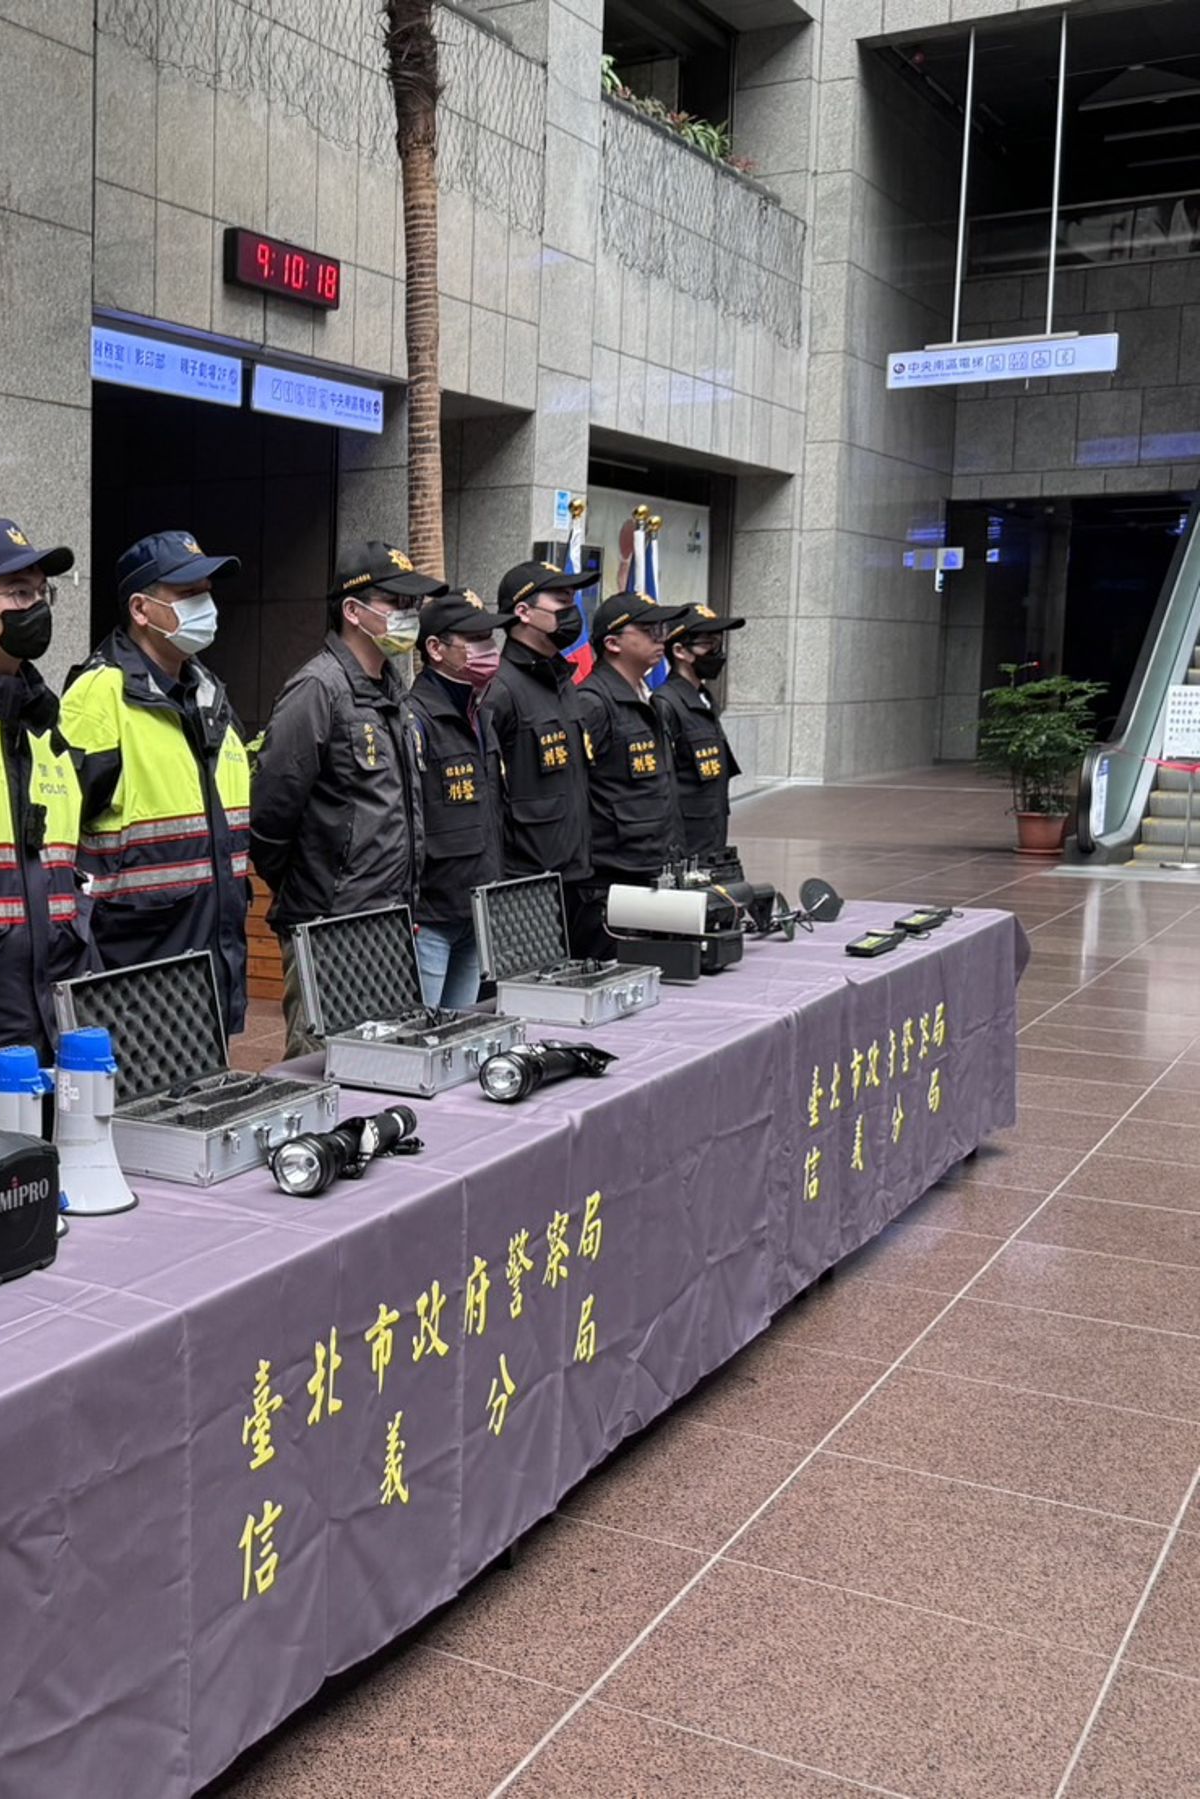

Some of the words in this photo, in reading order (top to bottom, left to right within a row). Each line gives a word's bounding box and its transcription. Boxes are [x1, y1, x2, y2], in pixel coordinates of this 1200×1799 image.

[257, 243, 337, 299] 9:10:18
[239, 1294, 596, 1600] 信義分局
[242, 1191, 602, 1470] 臺北市政府警察局
